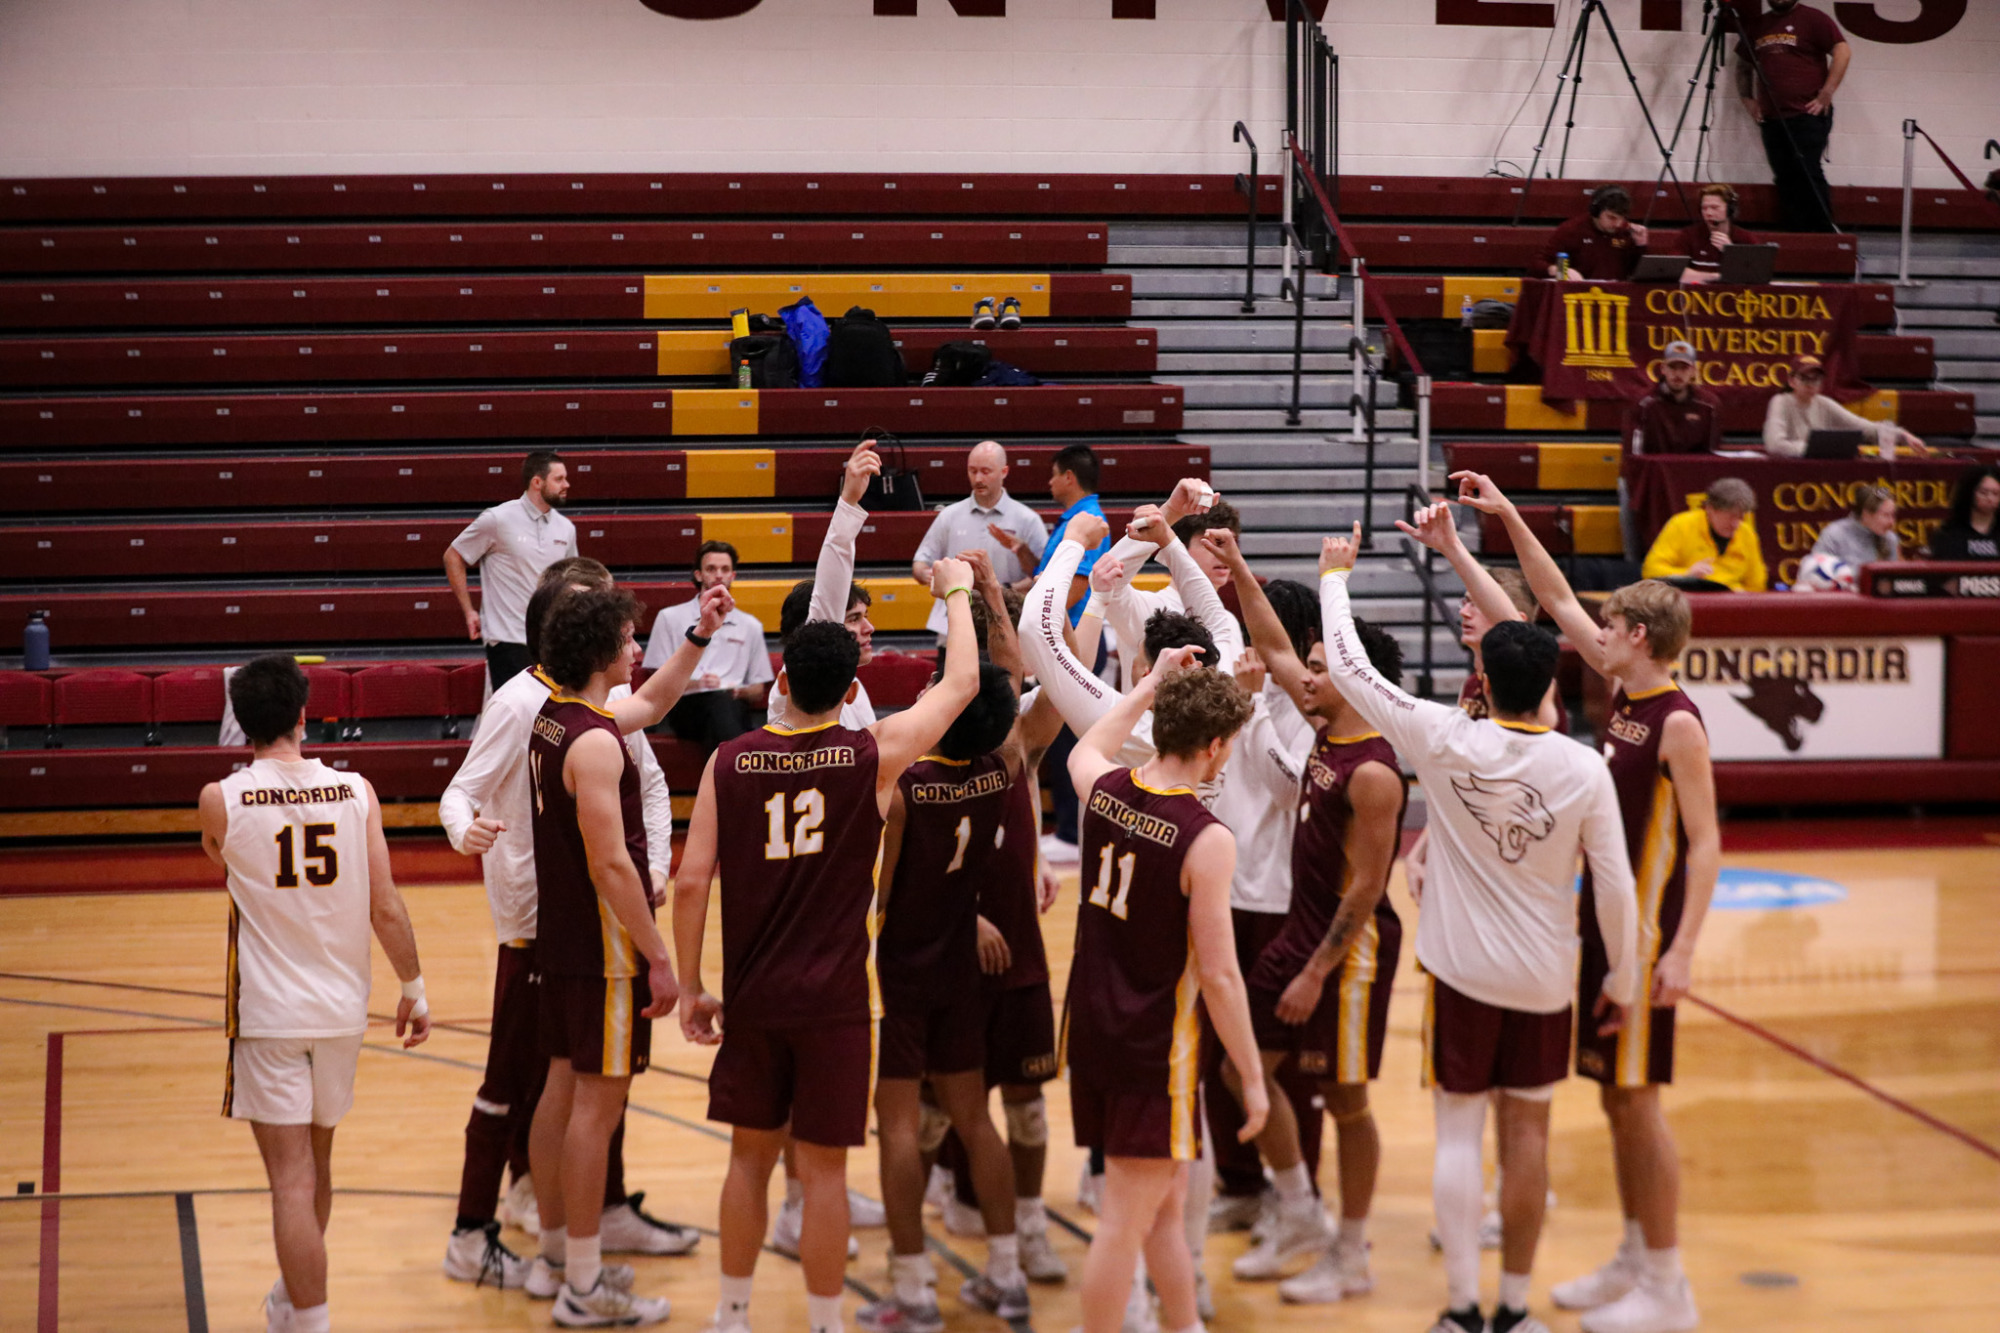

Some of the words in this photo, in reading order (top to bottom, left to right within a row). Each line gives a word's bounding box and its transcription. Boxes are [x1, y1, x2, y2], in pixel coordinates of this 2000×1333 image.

[1645, 288, 1832, 323] CONCORDIA
[1645, 359, 1792, 387] CICAGO
[1056, 652, 1103, 700] CONCORDIA
[735, 746, 856, 774] CONCORDIA
[765, 788, 825, 860] 12
[946, 815, 972, 874] 1
[1090, 789, 1179, 848] CONCORDIA
[275, 822, 339, 889] 15
[1088, 841, 1136, 921] 11
